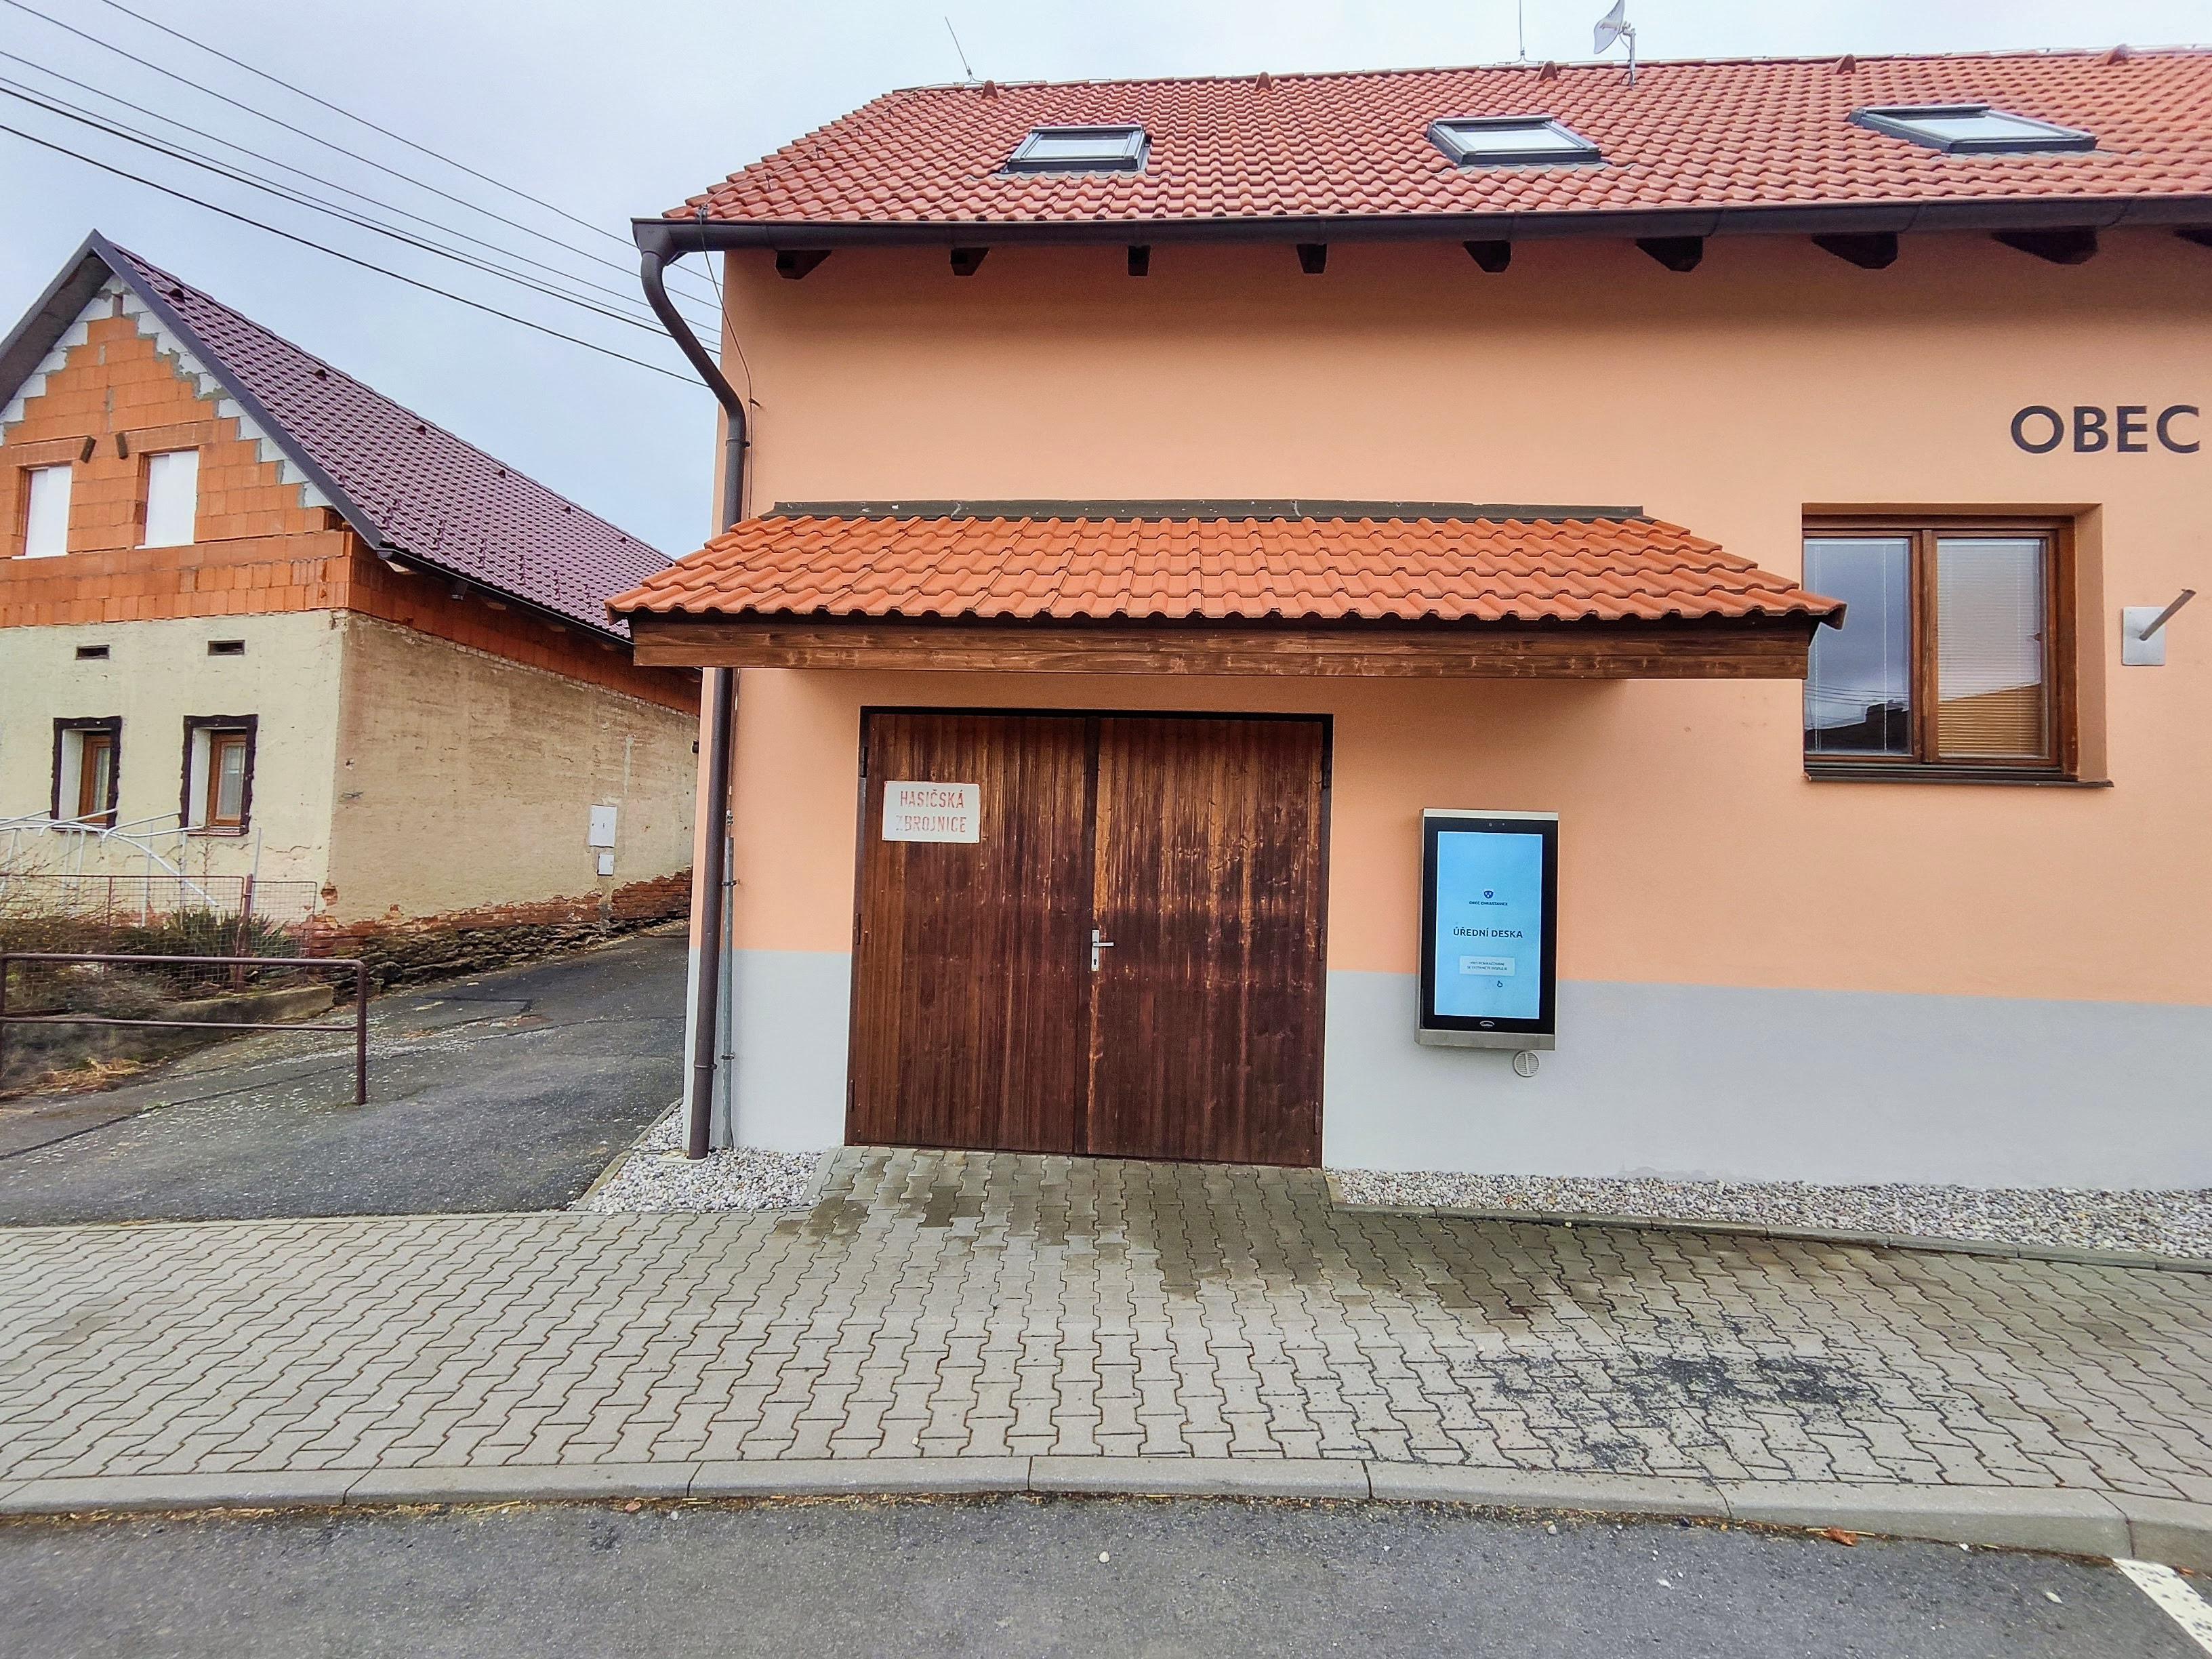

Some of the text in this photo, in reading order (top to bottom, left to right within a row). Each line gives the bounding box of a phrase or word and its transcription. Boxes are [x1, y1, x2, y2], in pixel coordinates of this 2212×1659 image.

[2011, 405, 2200, 453] OBEC
[899, 788, 964, 808] HASIČSKÁ
[895, 815, 967, 833] ZBROJNICE
[1453, 926, 1523, 938] ÚŘEDNÍ DESKA
